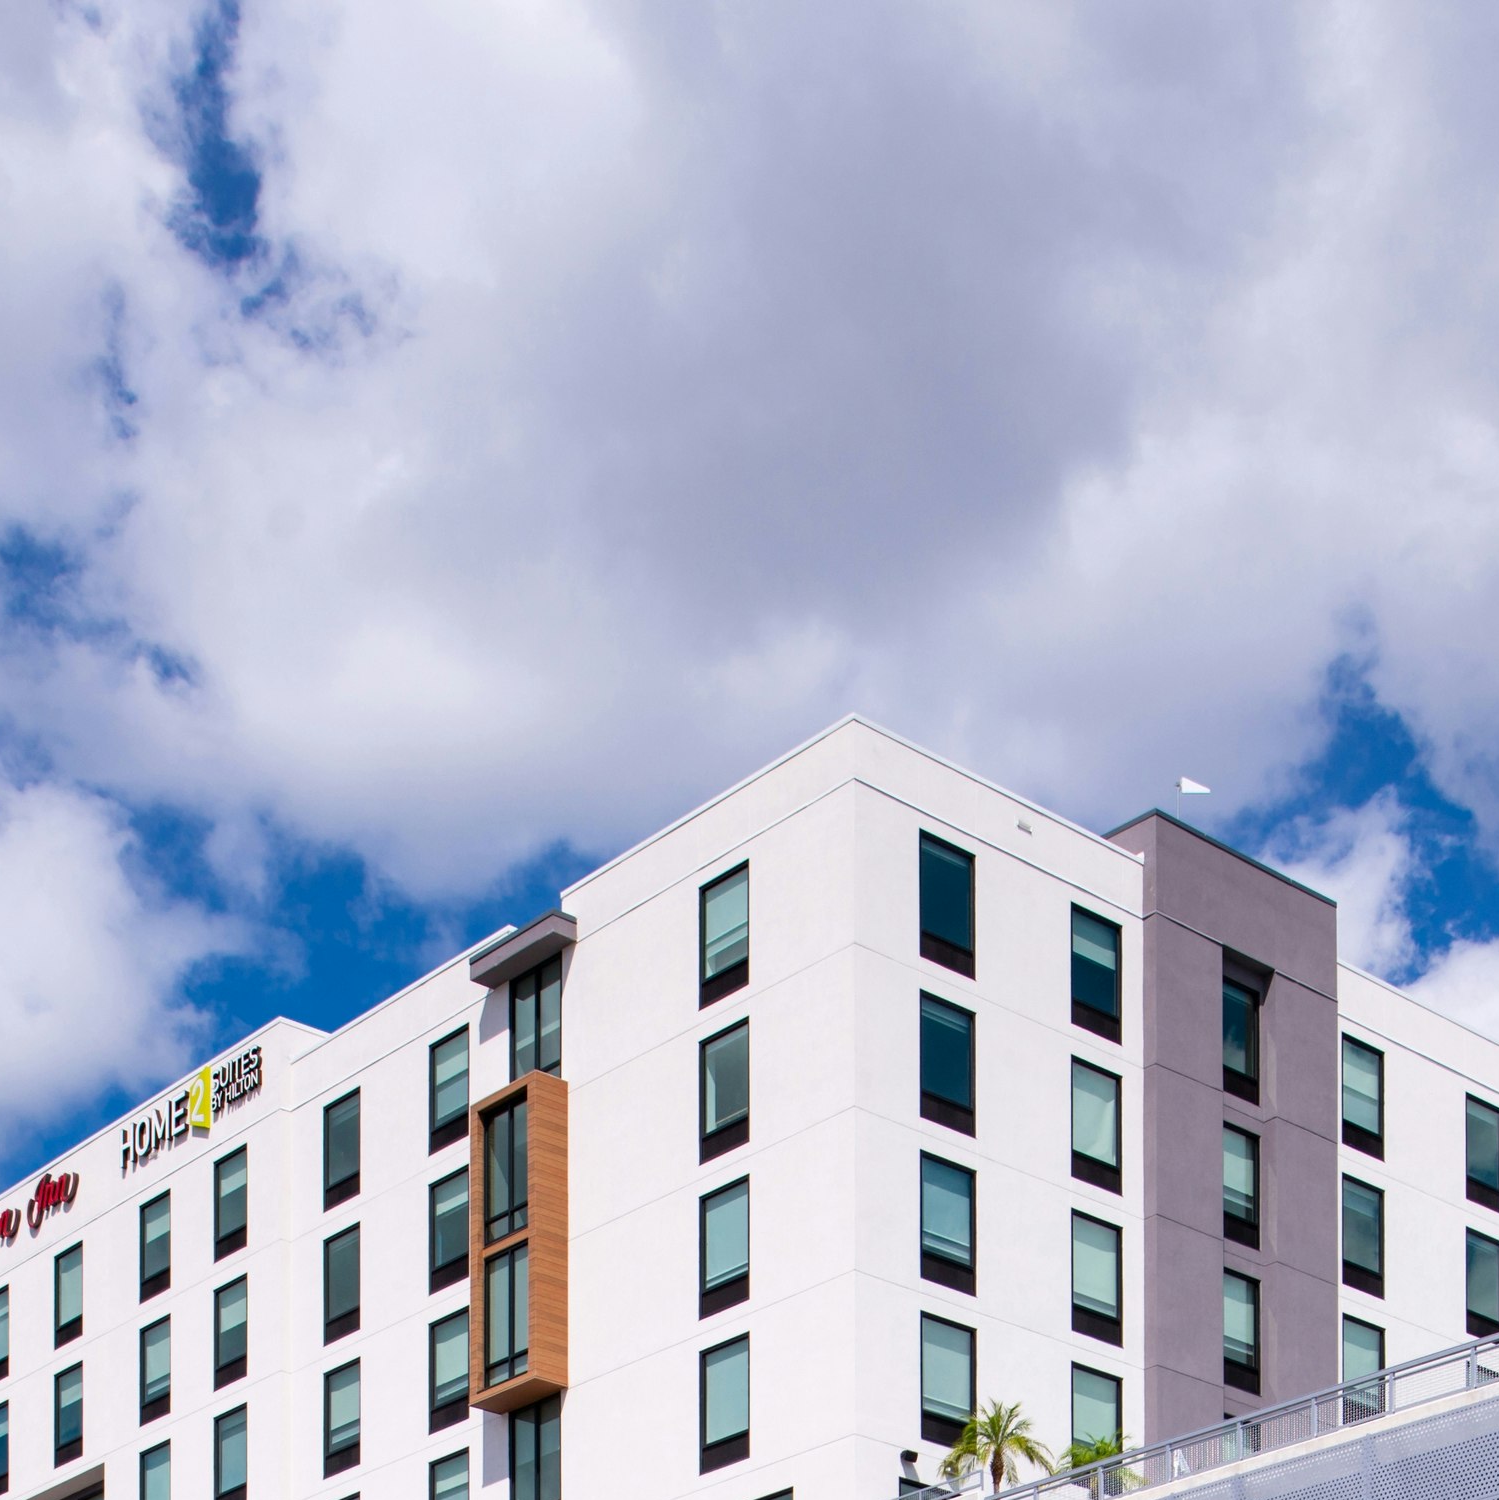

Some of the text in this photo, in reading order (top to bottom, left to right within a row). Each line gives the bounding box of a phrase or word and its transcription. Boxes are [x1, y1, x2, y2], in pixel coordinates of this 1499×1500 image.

[211, 1045, 262, 1093] SUITES
[211, 1069, 262, 1113] BY HILTON
[120, 1090, 190, 1169] HOME
[27, 1172, 79, 1229] Inn
